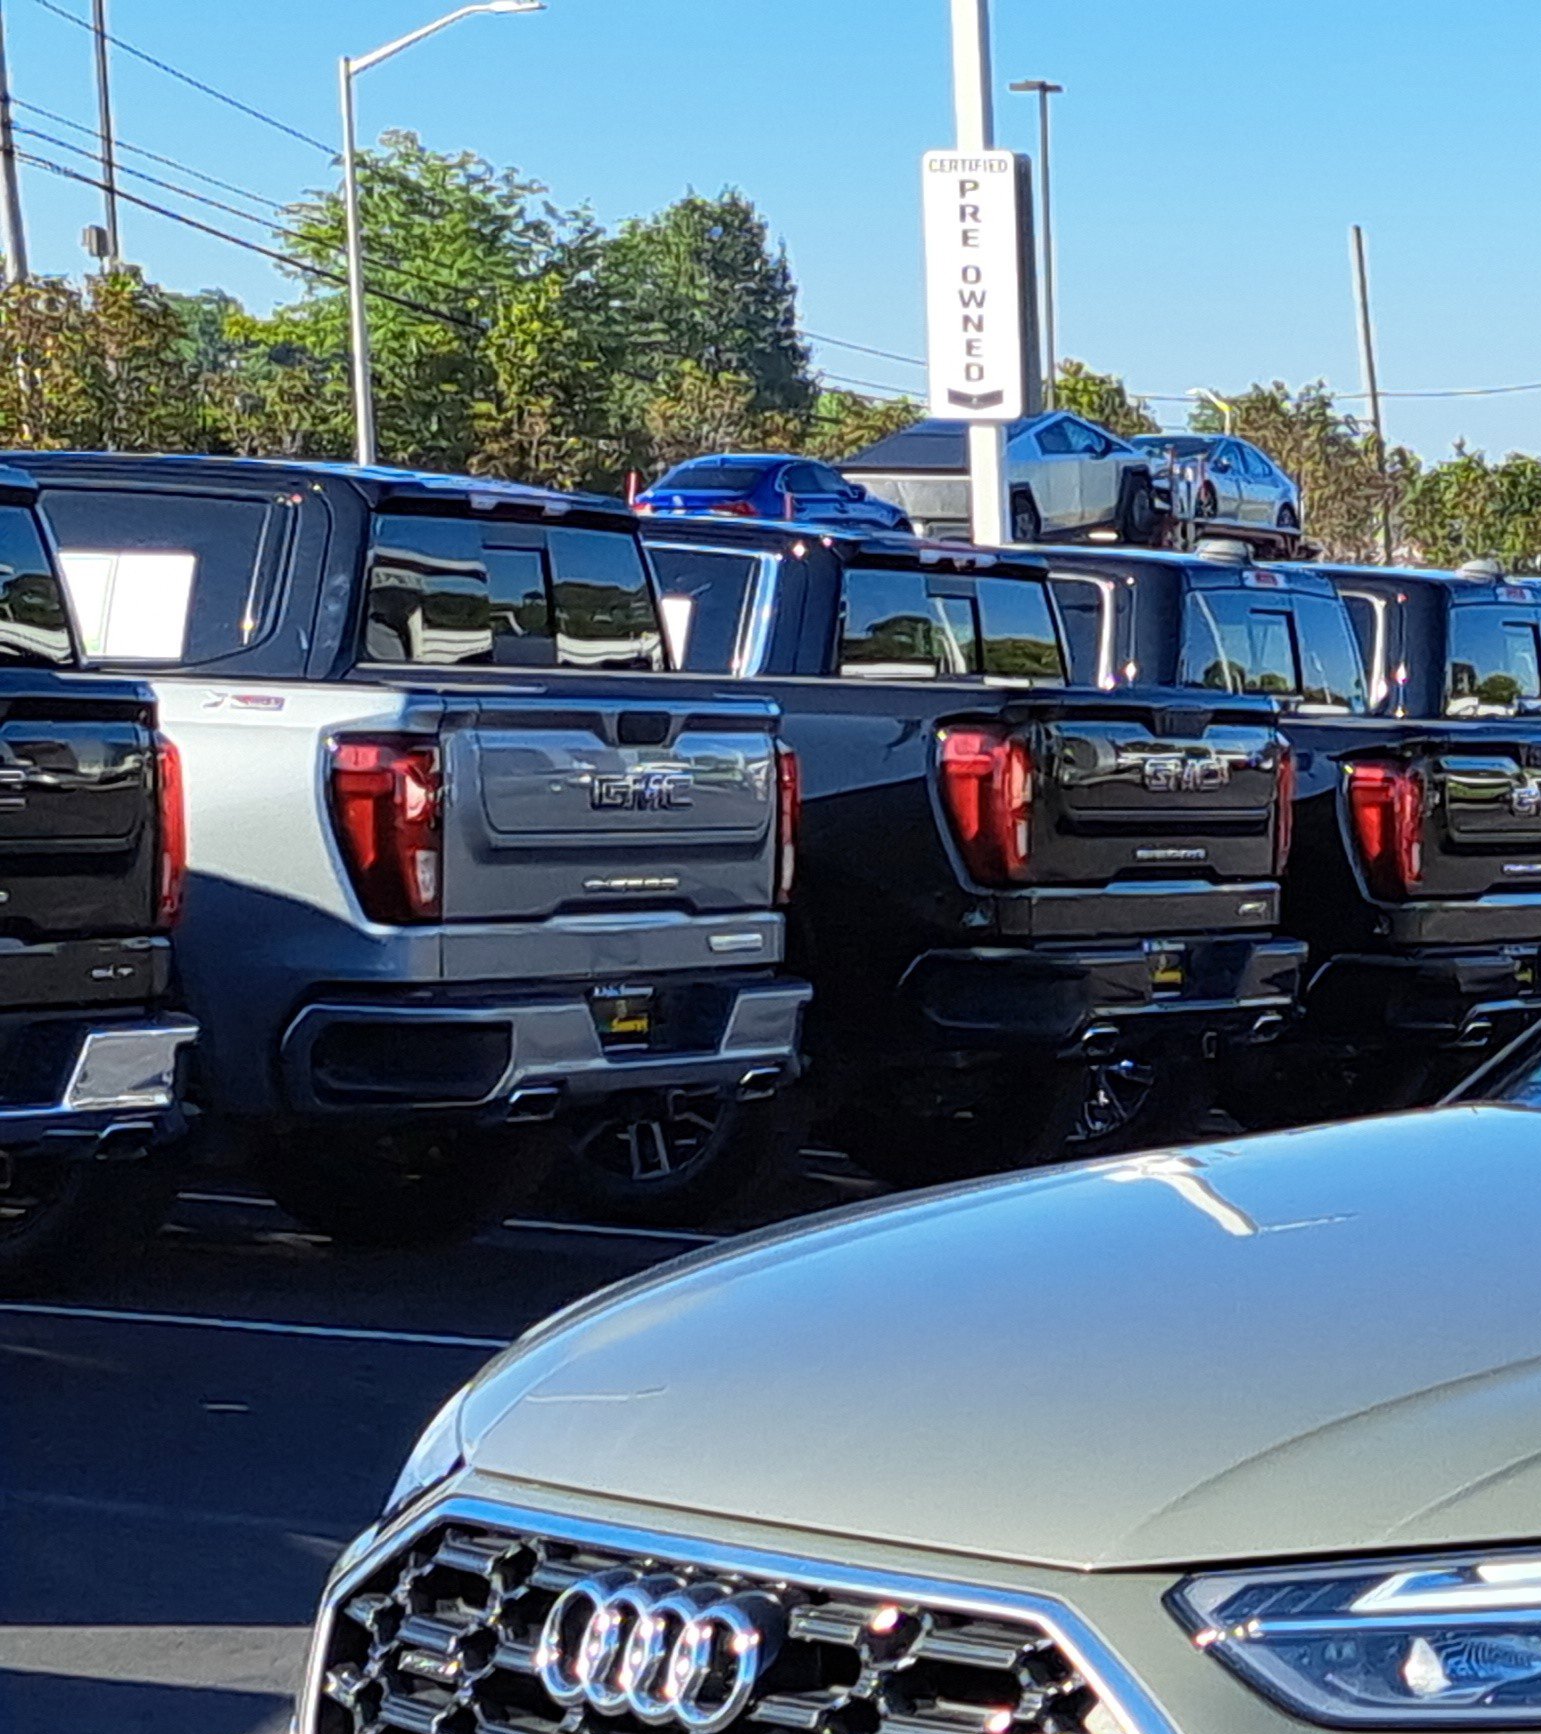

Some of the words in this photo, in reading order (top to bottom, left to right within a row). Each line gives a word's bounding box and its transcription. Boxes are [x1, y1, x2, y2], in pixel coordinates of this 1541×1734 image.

[928, 158, 1009, 174] CERTIFIED
[958, 179, 982, 249] PRE
[957, 264, 987, 383] OWNED
